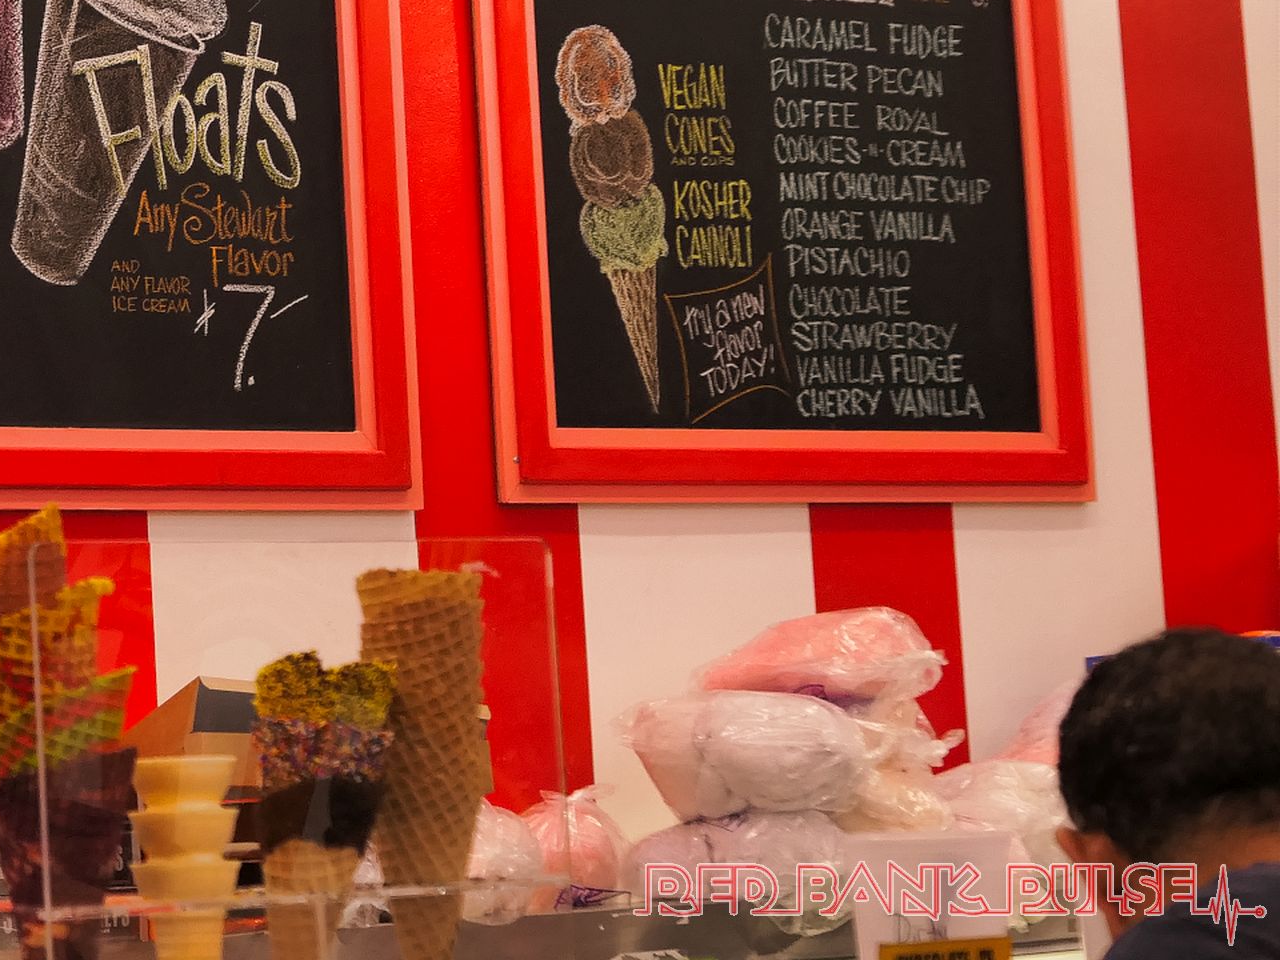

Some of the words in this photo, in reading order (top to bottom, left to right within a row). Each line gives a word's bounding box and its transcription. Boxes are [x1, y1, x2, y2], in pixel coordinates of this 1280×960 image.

[764, 13, 877, 52] CARAMEL
[888, 23, 964, 59] FUDGE
[658, 63, 728, 111] VEGAN
[770, 57, 858, 91] BUTTER
[866, 65, 944, 98] PECAN
[72, 22, 301, 198] Floats
[773, 96, 860, 129] COFFEE
[876, 104, 950, 136] ROYAL
[665, 112, 736, 156] CONES
[673, 179, 753, 221] KOSHER
[779, 171, 831, 202] MINT
[832, 171, 939, 203] CHOCOLATE
[940, 176, 992, 205] CHIP
[133, 190, 180, 252] Any
[181, 182, 296, 245] Stewart
[781, 207, 864, 240] ORANGE
[869, 210, 956, 244] VANILLA
[111, 259, 140, 274] AND
[210, 244, 294, 288] Flavor
[675, 223, 753, 269] CANNOLI
[784, 243, 910, 278] PISTACHIO
[111, 276, 141, 292] ANY
[144, 276, 192, 295] FLAVOR
[112, 297, 137, 313] ICE
[142, 298, 191, 313] CREAM
[788, 283, 912, 319] CHOCOLATE
[683, 304, 716, 348] try
[716, 299, 732, 329] a
[731, 283, 765, 323] new
[713, 320, 764, 368] flavor
[791, 321, 959, 352] STRAWBERRY
[700, 343, 776, 398] TODAY!
[796, 354, 885, 387] VANILLA
[889, 353, 965, 384] FUDGE
[796, 388, 882, 418] CHERRY
[889, 383, 986, 419] VANILLA
